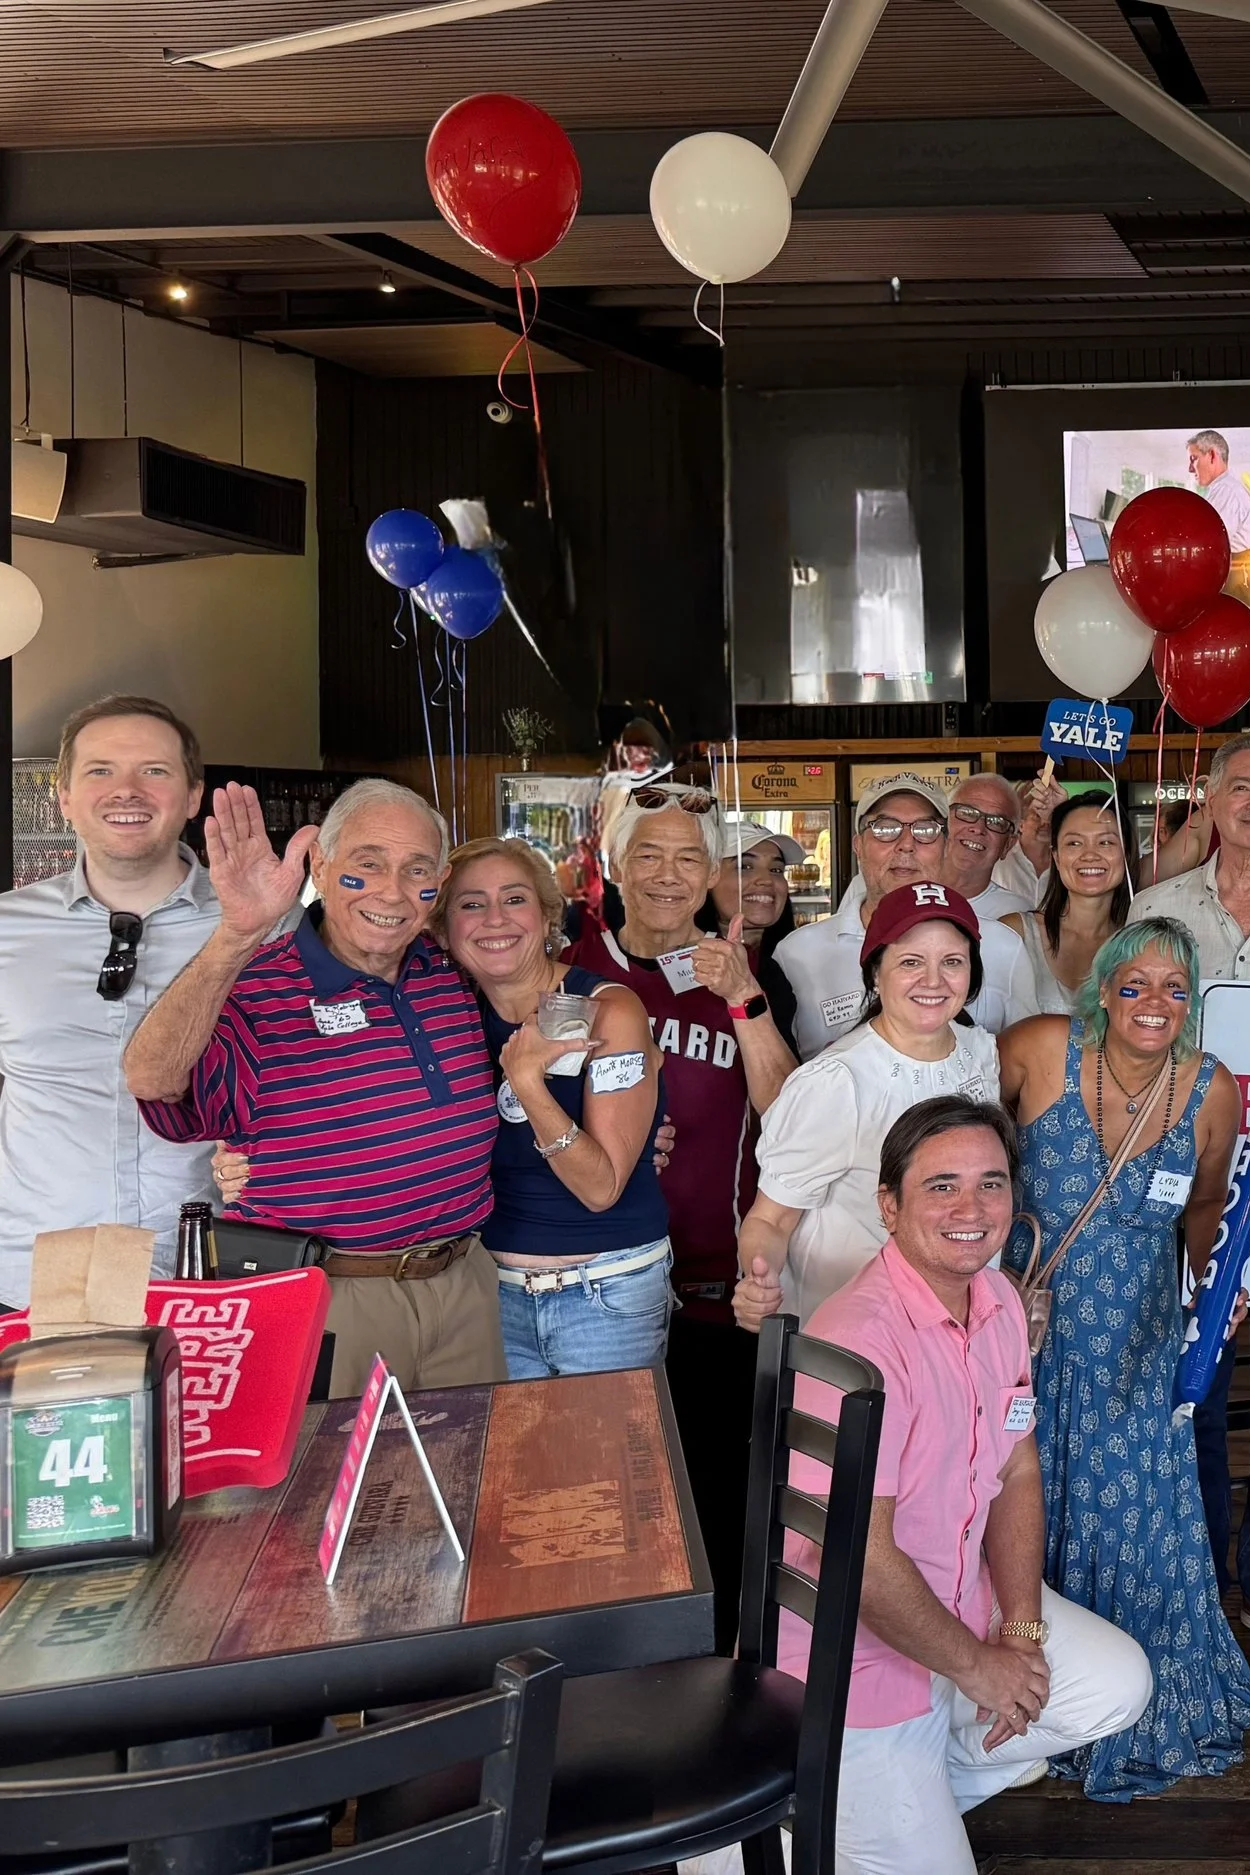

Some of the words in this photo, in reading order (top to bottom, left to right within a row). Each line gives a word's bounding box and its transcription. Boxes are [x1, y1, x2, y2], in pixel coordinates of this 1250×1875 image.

[1063, 711, 1097, 724] LETS
[1099, 716, 1117, 726] GO
[1049, 721, 1124, 752] YALE
[751, 774, 799, 792] Corona
[764, 787, 788, 798] Extra
[911, 883, 950, 907] H
[832, 993, 860, 1006] HARVARD
[38, 1435, 109, 1488] 44
[357, 1480, 394, 1523] GUEVARA
